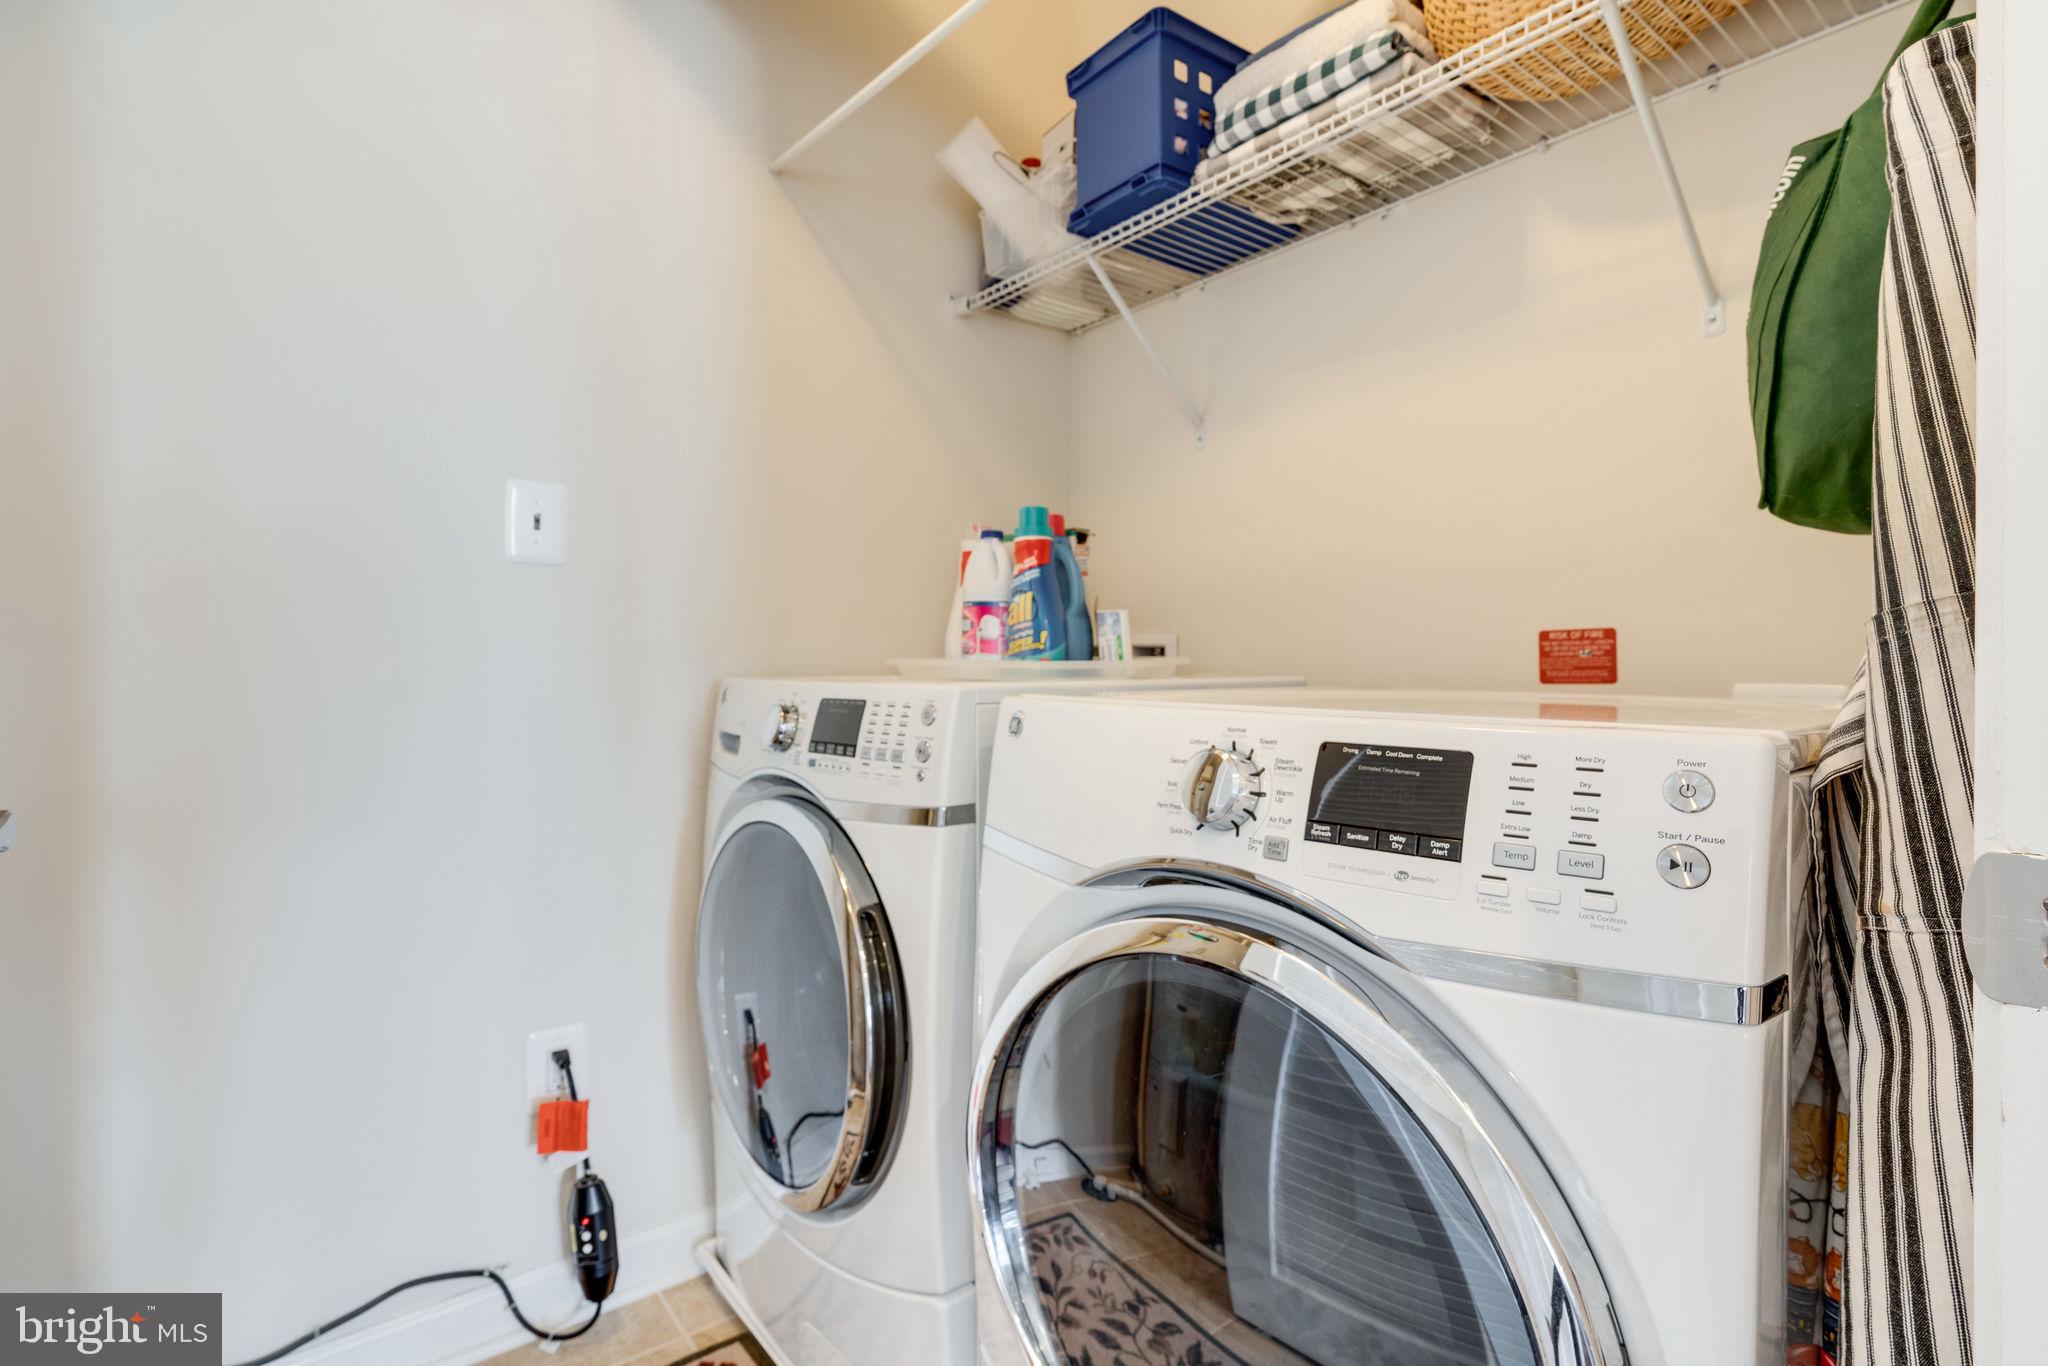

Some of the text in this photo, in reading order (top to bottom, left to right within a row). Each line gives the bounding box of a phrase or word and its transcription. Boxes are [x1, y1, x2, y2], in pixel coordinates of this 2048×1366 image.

[1767, 155, 1807, 221] .com
[1366, 748, 1382, 757] Damp
[1385, 750, 1414, 759] Cool Down
[1517, 753, 1532, 761] High
[1275, 757, 1295, 766] Steam
[1416, 753, 1443, 762] Complete
[1594, 757, 1606, 765] Dry
[1677, 759, 1708, 768] Power
[1358, 764, 1420, 777] Estimated Time Remaining
[1509, 776, 1535, 784] Medium
[1579, 781, 1592, 790] Dry
[1276, 790, 1294, 798] Warm
[1570, 805, 1600, 815] Less Dry
[1278, 817, 1293, 825] Fluff
[1170, 827, 1183, 835] Quick
[1312, 823, 1331, 831] Steam
[1500, 823, 1531, 833] Extra Low
[1311, 829, 1331, 838] Refresh
[1346, 832, 1369, 842] Sanitize
[1572, 831, 1593, 841] Damp
[1657, 831, 1683, 841] Start
[1694, 834, 1726, 845] Pause
[1248, 837, 1263, 845] Time
[1389, 834, 1407, 843] Delay
[1248, 844, 1258, 853] Dry
[1267, 841, 1280, 849] Add
[1391, 841, 1404, 851] Dry
[1430, 840, 1450, 850] Damp
[1432, 848, 1449, 857] Alert
[1503, 850, 1529, 862] Temp
[1568, 857, 1595, 869] Level
[1535, 904, 1560, 915] Volume
[1578, 912, 1628, 926] Lock Controls
